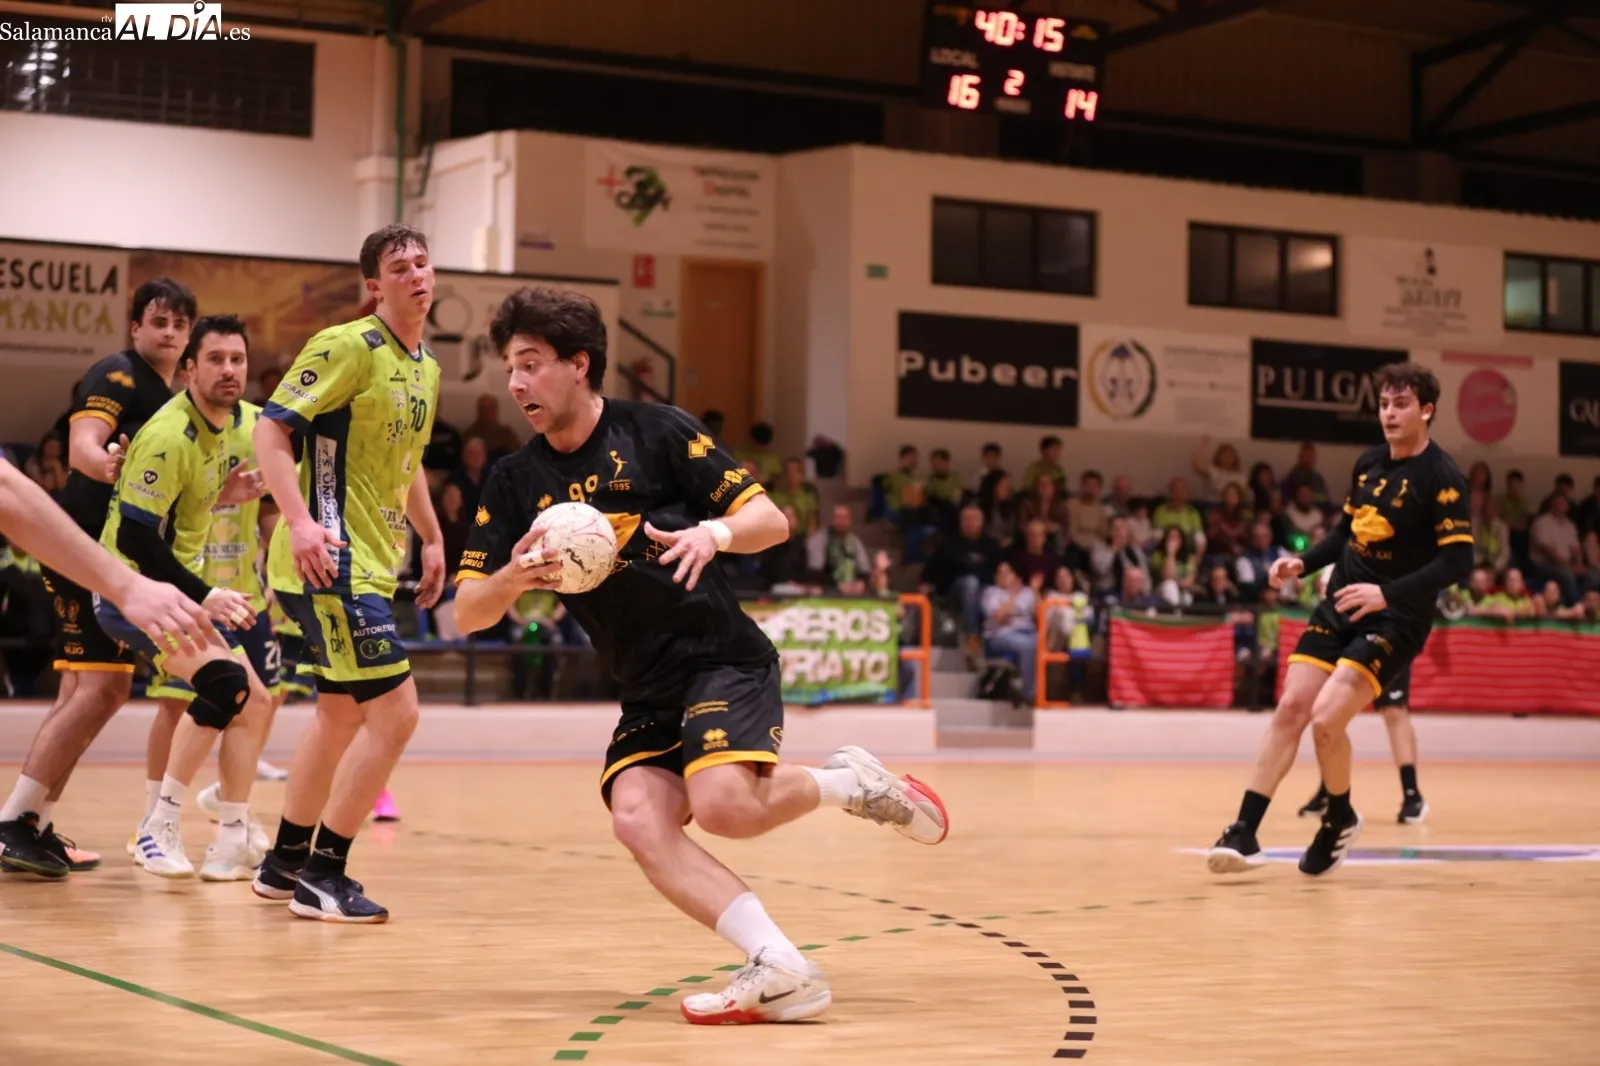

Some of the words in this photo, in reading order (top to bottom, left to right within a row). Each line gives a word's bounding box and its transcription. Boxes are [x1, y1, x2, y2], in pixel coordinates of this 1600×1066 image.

[947, 74, 981, 109] 16
[1004, 69, 1024, 95] 2
[1065, 88, 1098, 121] 14
[899, 350, 1078, 388] Pubeer
[1257, 363, 1377, 411] PUIGA
[609, 482, 630, 491] 1995
